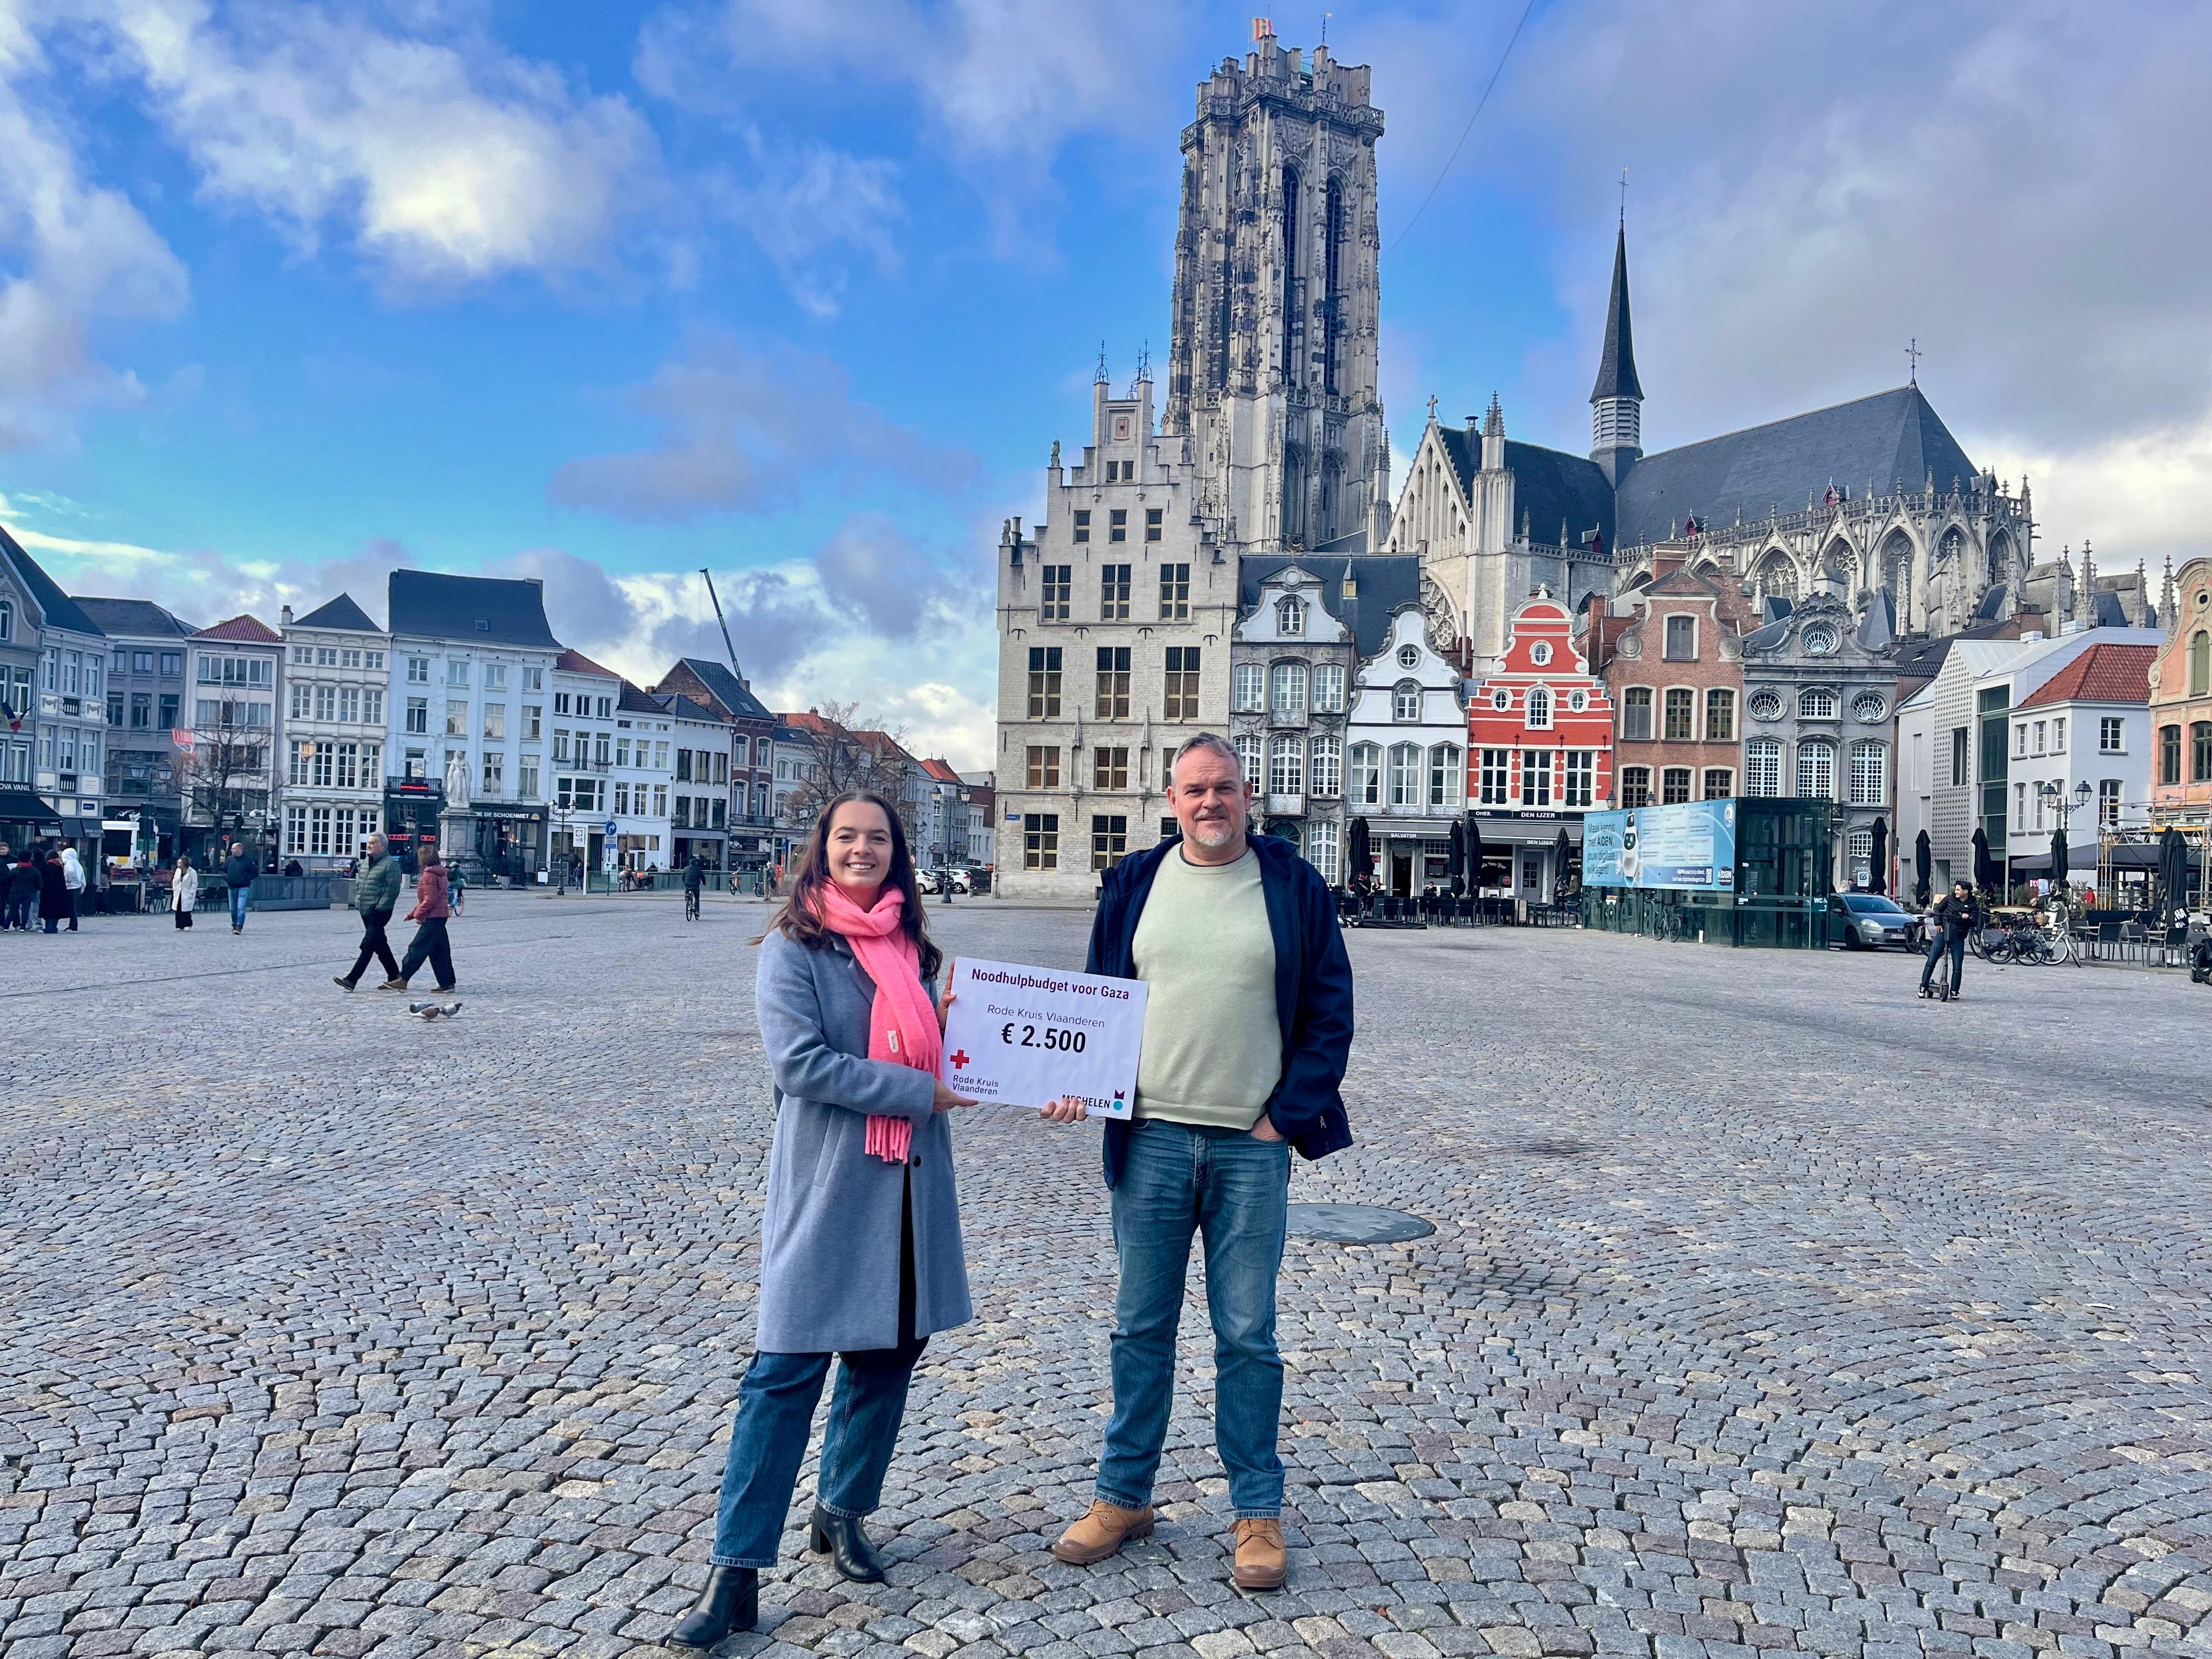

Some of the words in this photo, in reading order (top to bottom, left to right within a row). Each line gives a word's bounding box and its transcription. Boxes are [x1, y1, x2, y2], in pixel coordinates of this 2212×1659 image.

[972, 968, 1068, 992] Noodhulpbudget
[1072, 984, 1097, 995] voor
[1101, 986, 1129, 1000] Gaza
[988, 1005, 1014, 1016] Rode
[1018, 1008, 1042, 1020] Kruis
[1047, 1012, 1105, 1028] Vlaanderen
[1001, 1023, 1015, 1044] €
[1021, 1025, 1086, 1053] 2.500
[953, 1075, 974, 1084] Rode
[977, 1077, 998, 1087] Kruis
[953, 1083, 997, 1095] Vlaanderen
